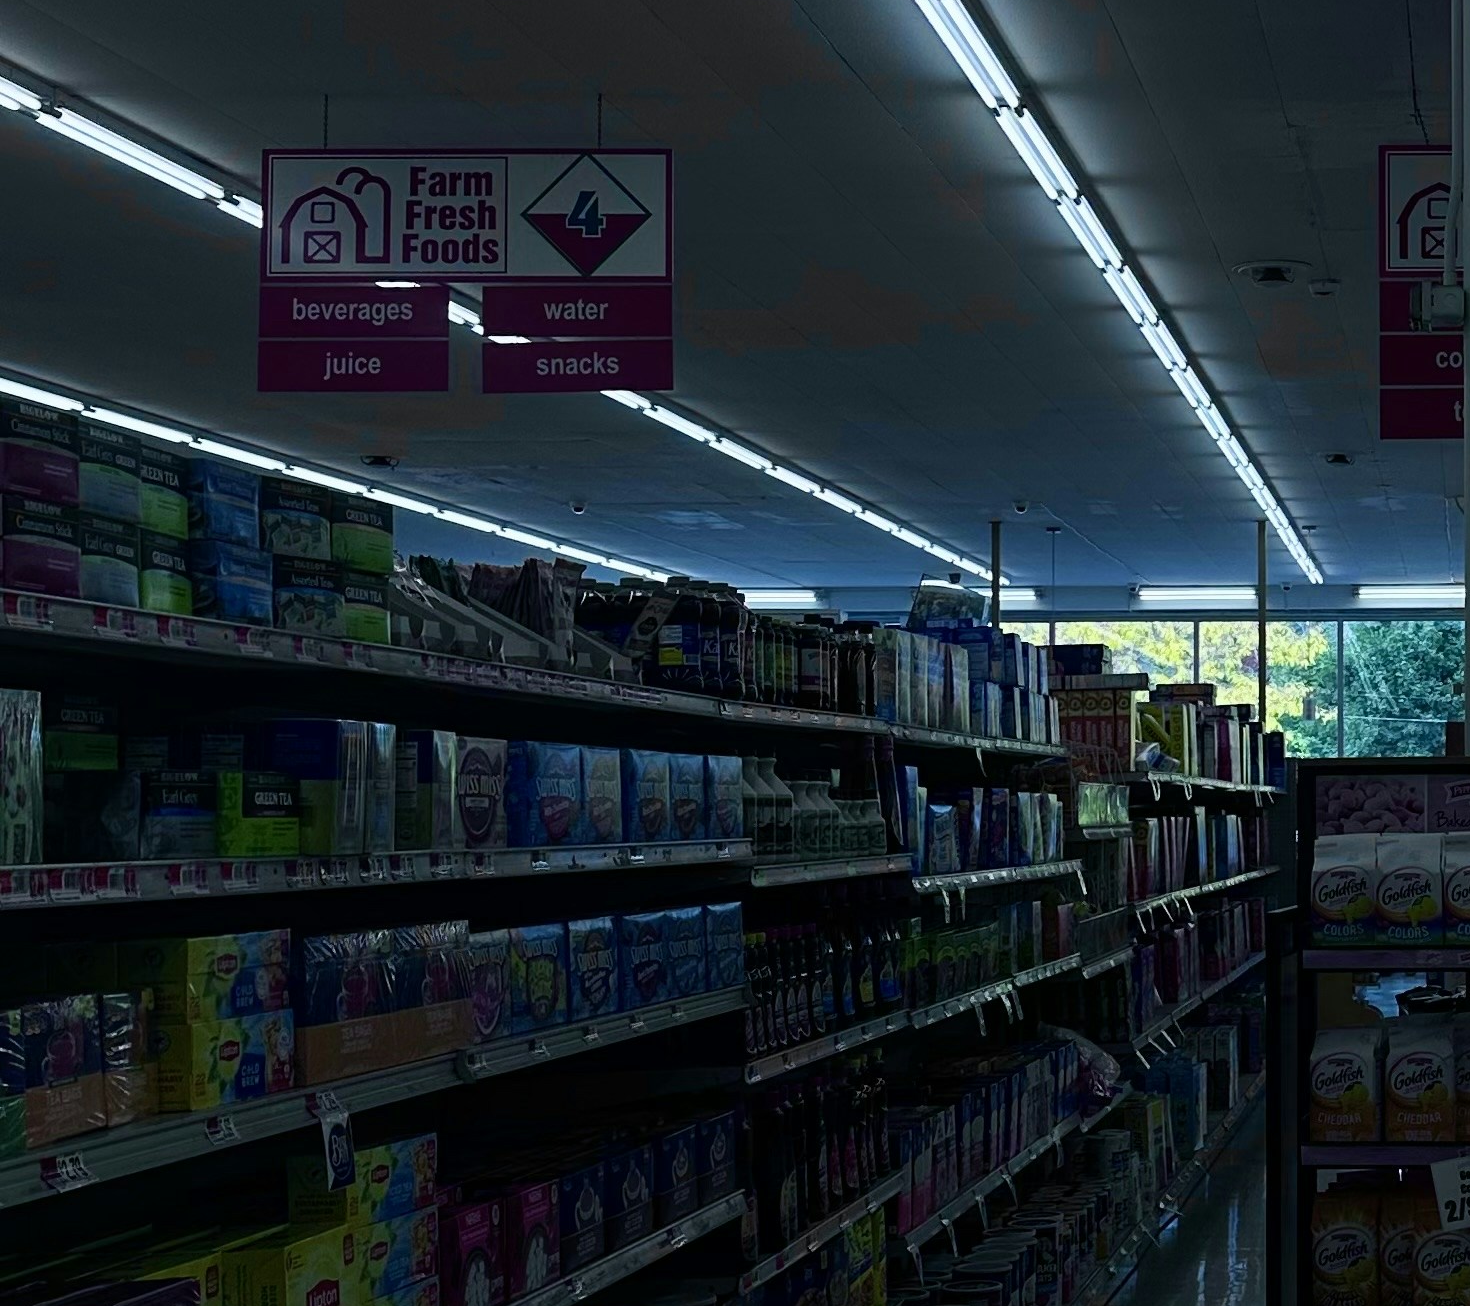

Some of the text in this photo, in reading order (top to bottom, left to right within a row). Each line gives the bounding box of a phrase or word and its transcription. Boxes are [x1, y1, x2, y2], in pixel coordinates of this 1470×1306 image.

[410, 166, 493, 196] Farm
[406, 200, 496, 230] Fresh
[566, 190, 606, 237] 4
[402, 233, 499, 264] Foods
[292, 298, 413, 324] beverages
[543, 300, 608, 320] water
[324, 353, 381, 380] juice
[536, 353, 619, 375] snacks
[1436, 349, 1464, 369] co
[165, 471, 180, 488] TEA
[345, 509, 383, 526] GREEN TEA
[173, 553, 186, 573] TEA
[370, 590, 383, 603] TEA
[60, 708, 88, 723] GREEN
[254, 791, 292, 806] GREEN TEA
[1318, 877, 1369, 903] Goldfish
[1381, 879, 1432, 908] Goldfish
[1324, 923, 1364, 937] COLORS
[1387, 925, 1429, 939] COLORS
[1314, 1068, 1364, 1092] Goldfish
[1393, 1066, 1443, 1092] Goldfish
[1317, 1111, 1362, 1126] CHEDDAR
[1397, 1111, 1442, 1125] CHEDDAR
[1318, 1241, 1369, 1267] Goldfish
